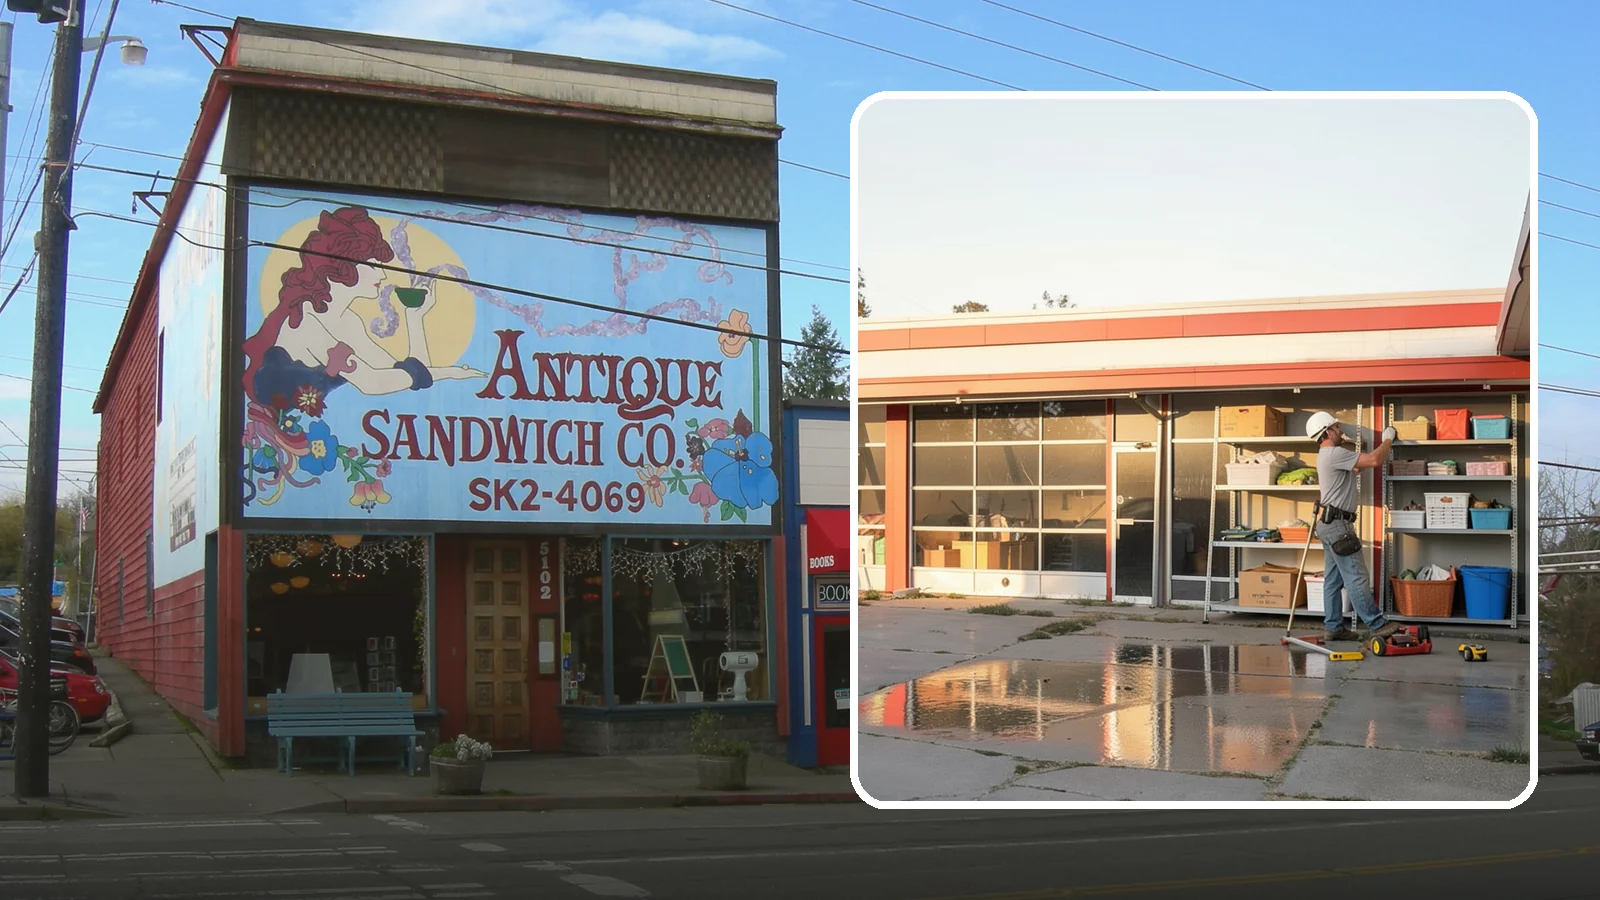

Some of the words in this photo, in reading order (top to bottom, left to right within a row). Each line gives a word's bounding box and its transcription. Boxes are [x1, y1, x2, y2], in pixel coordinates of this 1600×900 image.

[475, 329, 723, 421] ANTIQUE
[361, 408, 604, 467] SANDWICH
[617, 422, 686, 469] CO.
[468, 478, 646, 513] SK2-4069
[539, 541, 552, 600] 5102
[809, 555, 835, 569] BOOKS
